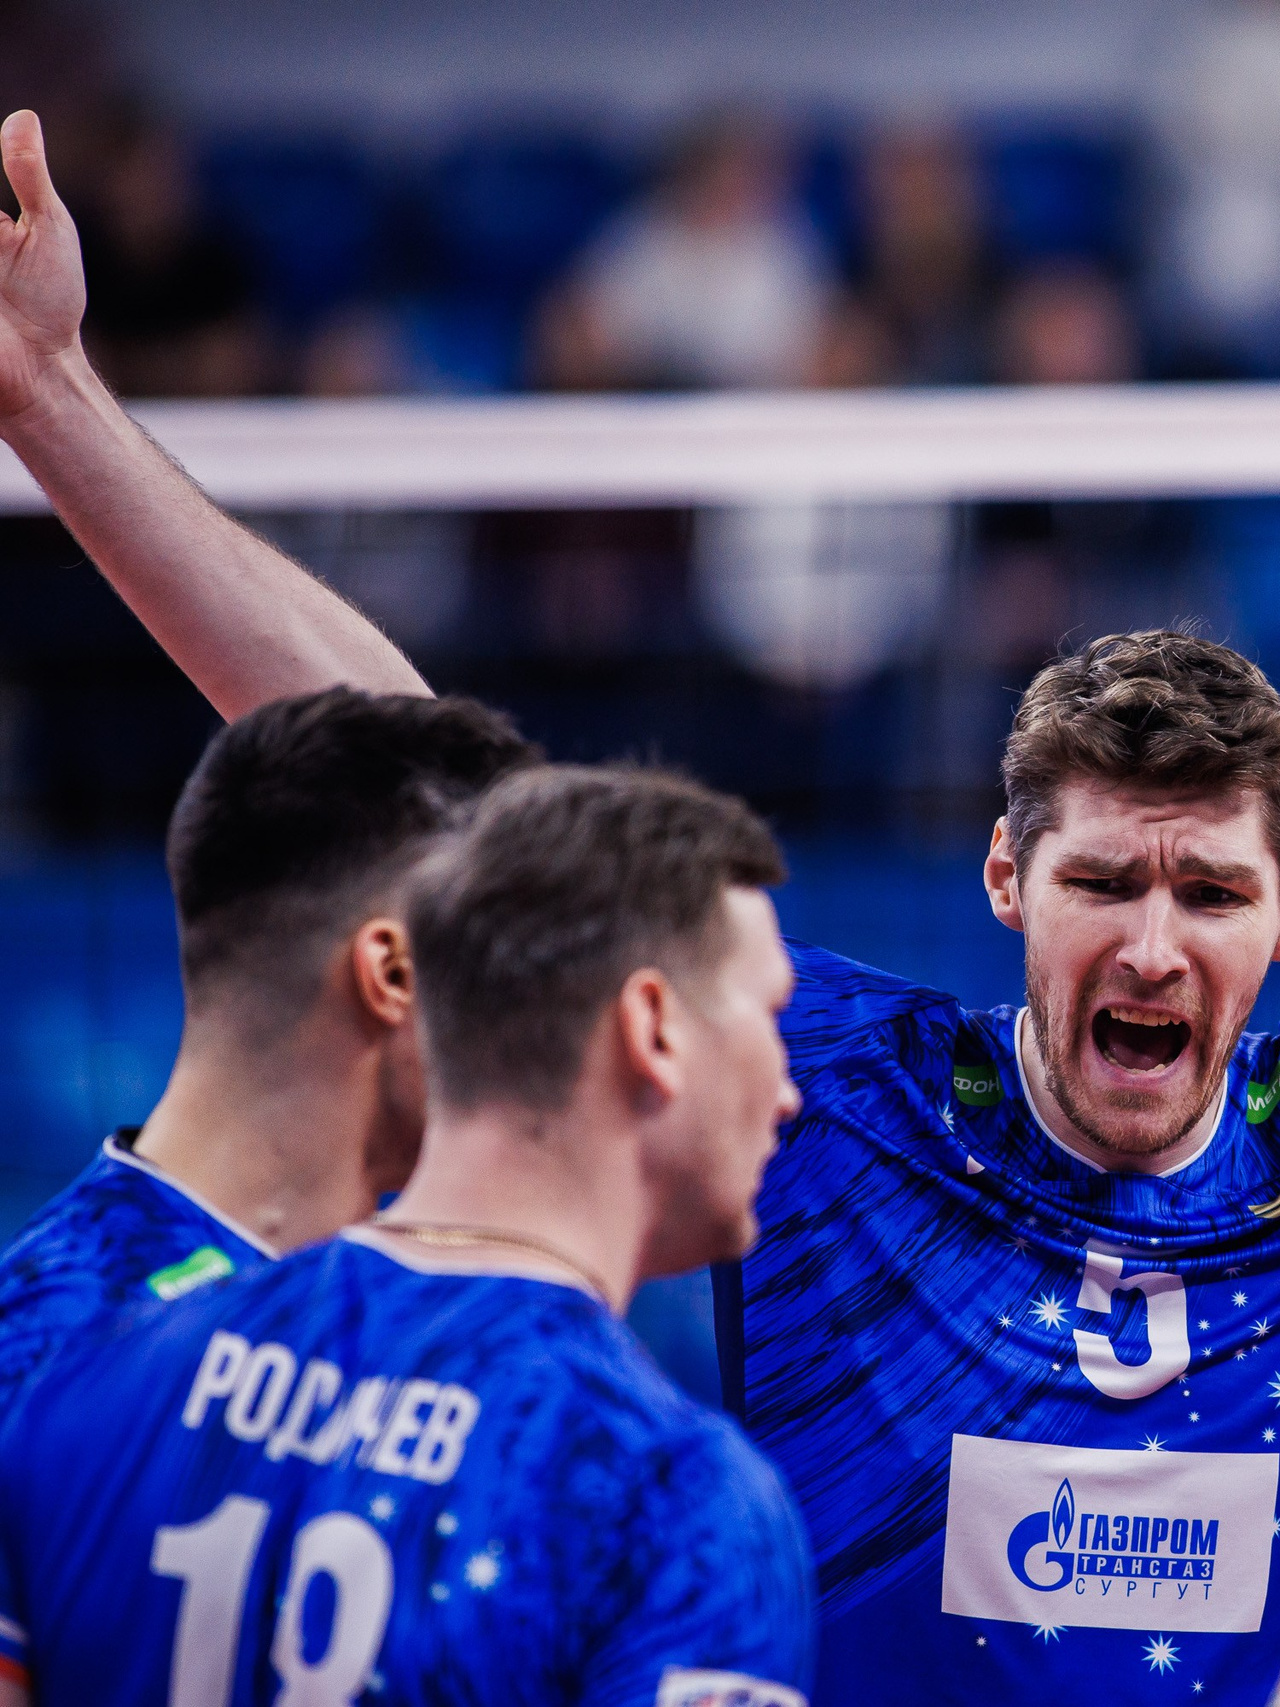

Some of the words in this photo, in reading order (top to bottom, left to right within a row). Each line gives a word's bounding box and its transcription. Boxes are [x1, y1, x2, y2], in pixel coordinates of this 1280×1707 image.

[1073, 1238, 1191, 1400] 5
[1078, 1513, 1220, 1556] ГАЗПРОМ
[1080, 1555, 1212, 1579] ТРАНСГАЗ
[150, 1493, 396, 1707] 18
[1074, 1577, 1213, 1601] СУРГУТ
